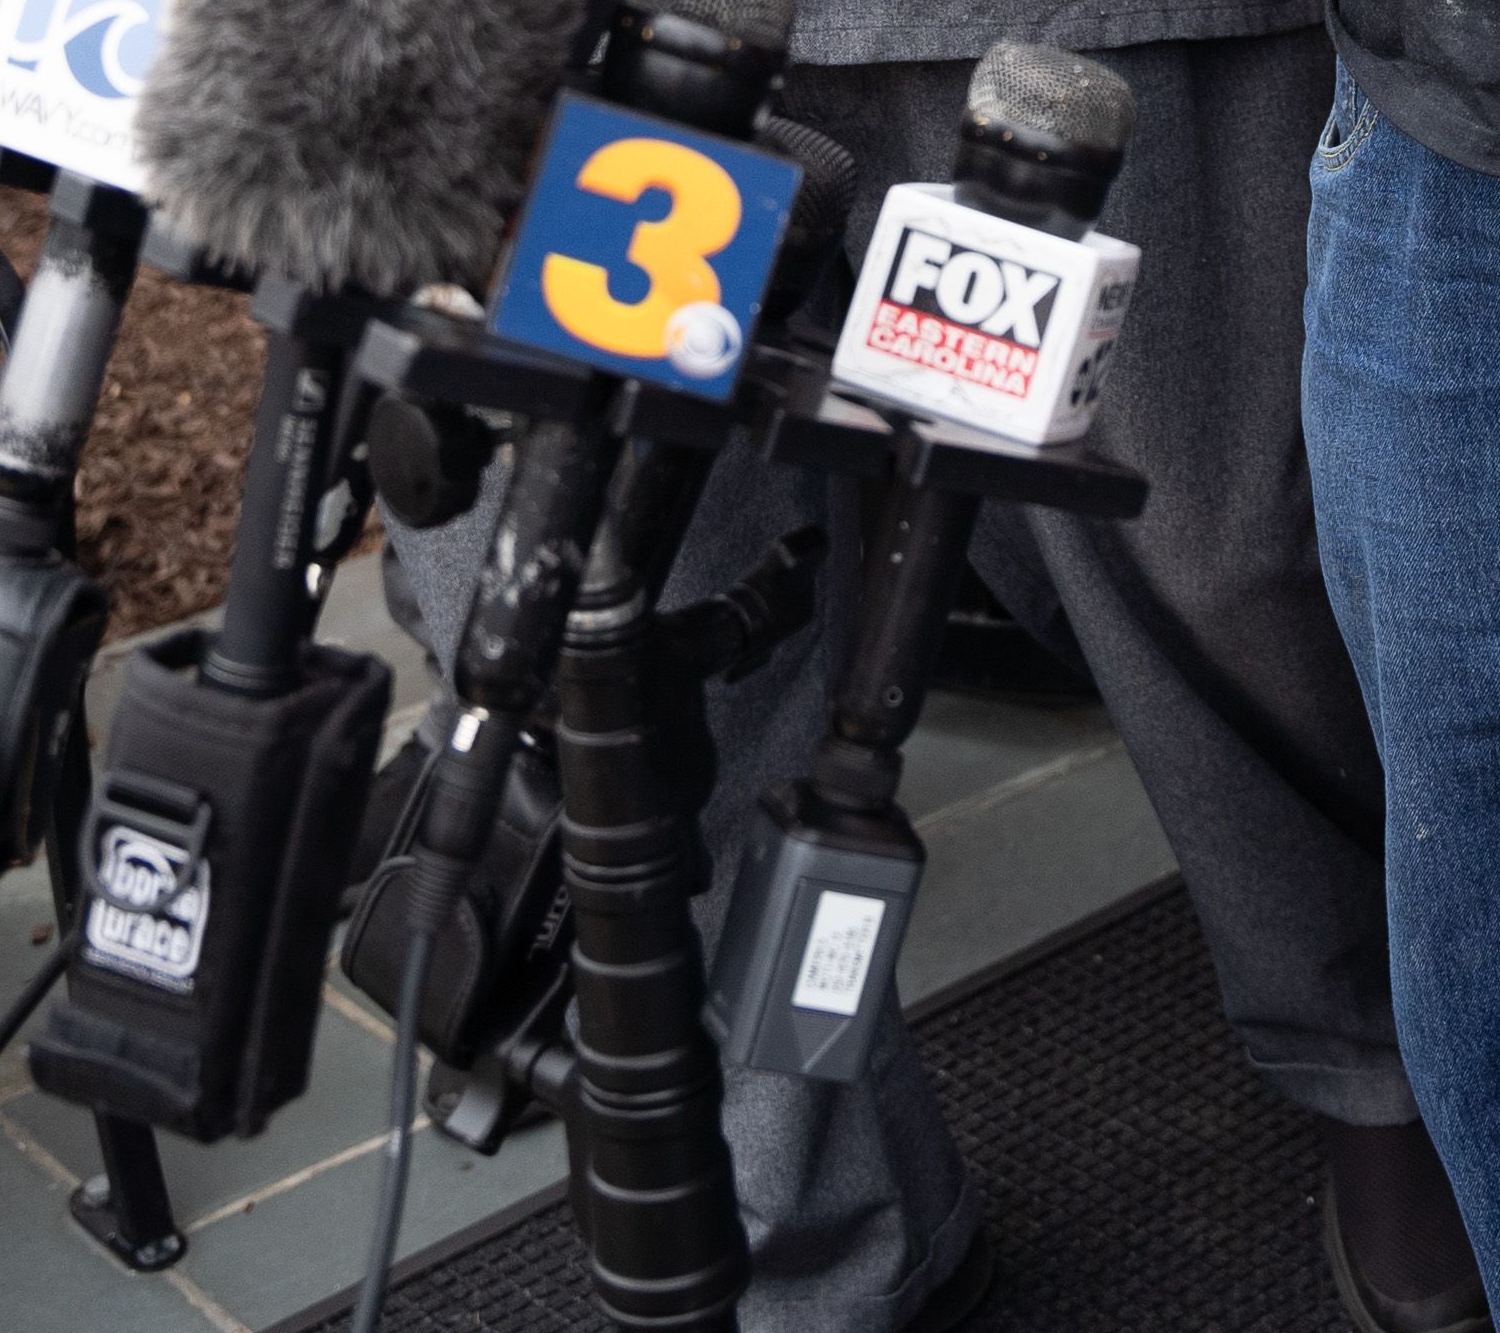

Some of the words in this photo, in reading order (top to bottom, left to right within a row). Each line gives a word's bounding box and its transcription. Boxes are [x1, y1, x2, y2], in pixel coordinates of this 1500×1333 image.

[542, 137, 743, 360] 3
[889, 230, 1058, 348] FOX
[868, 326, 1029, 396] CAROLINA
[876, 302, 1038, 376] EASTERN
